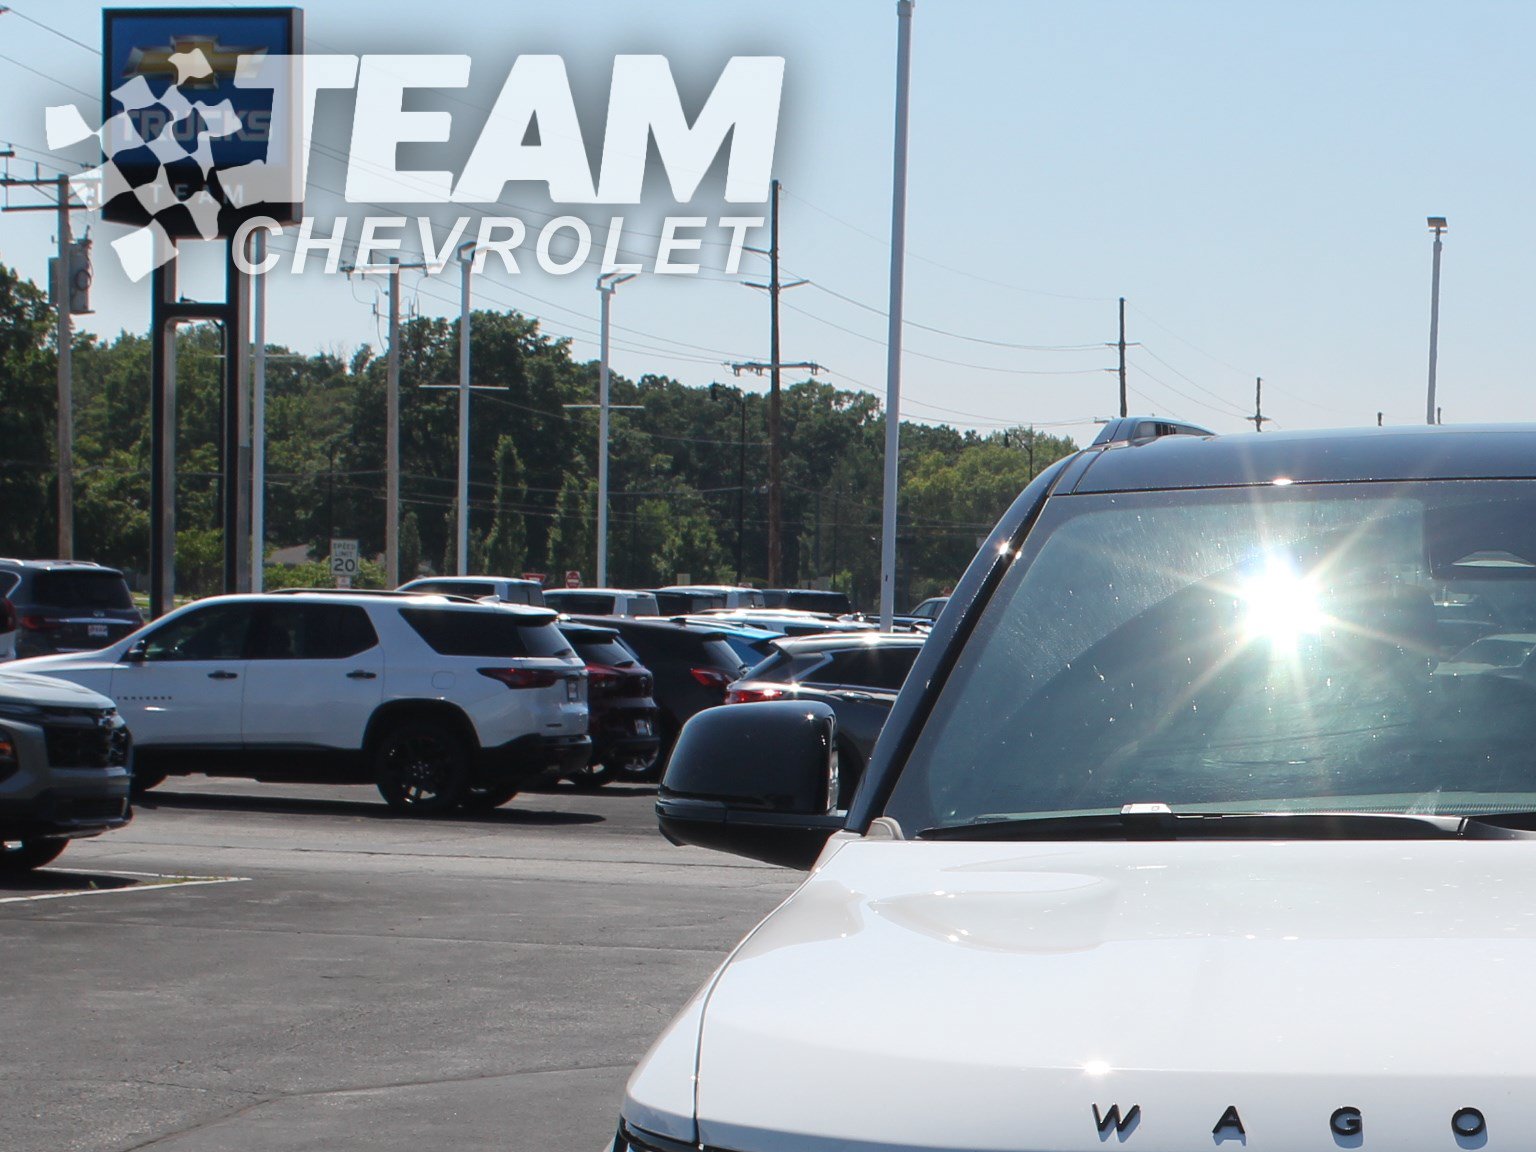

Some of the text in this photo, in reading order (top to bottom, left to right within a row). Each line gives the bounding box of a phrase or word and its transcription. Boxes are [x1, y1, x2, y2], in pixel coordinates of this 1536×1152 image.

[116, 109, 273, 142] TRUCKS
[151, 184, 244, 204] TEAM
[333, 558, 356, 572] 20
